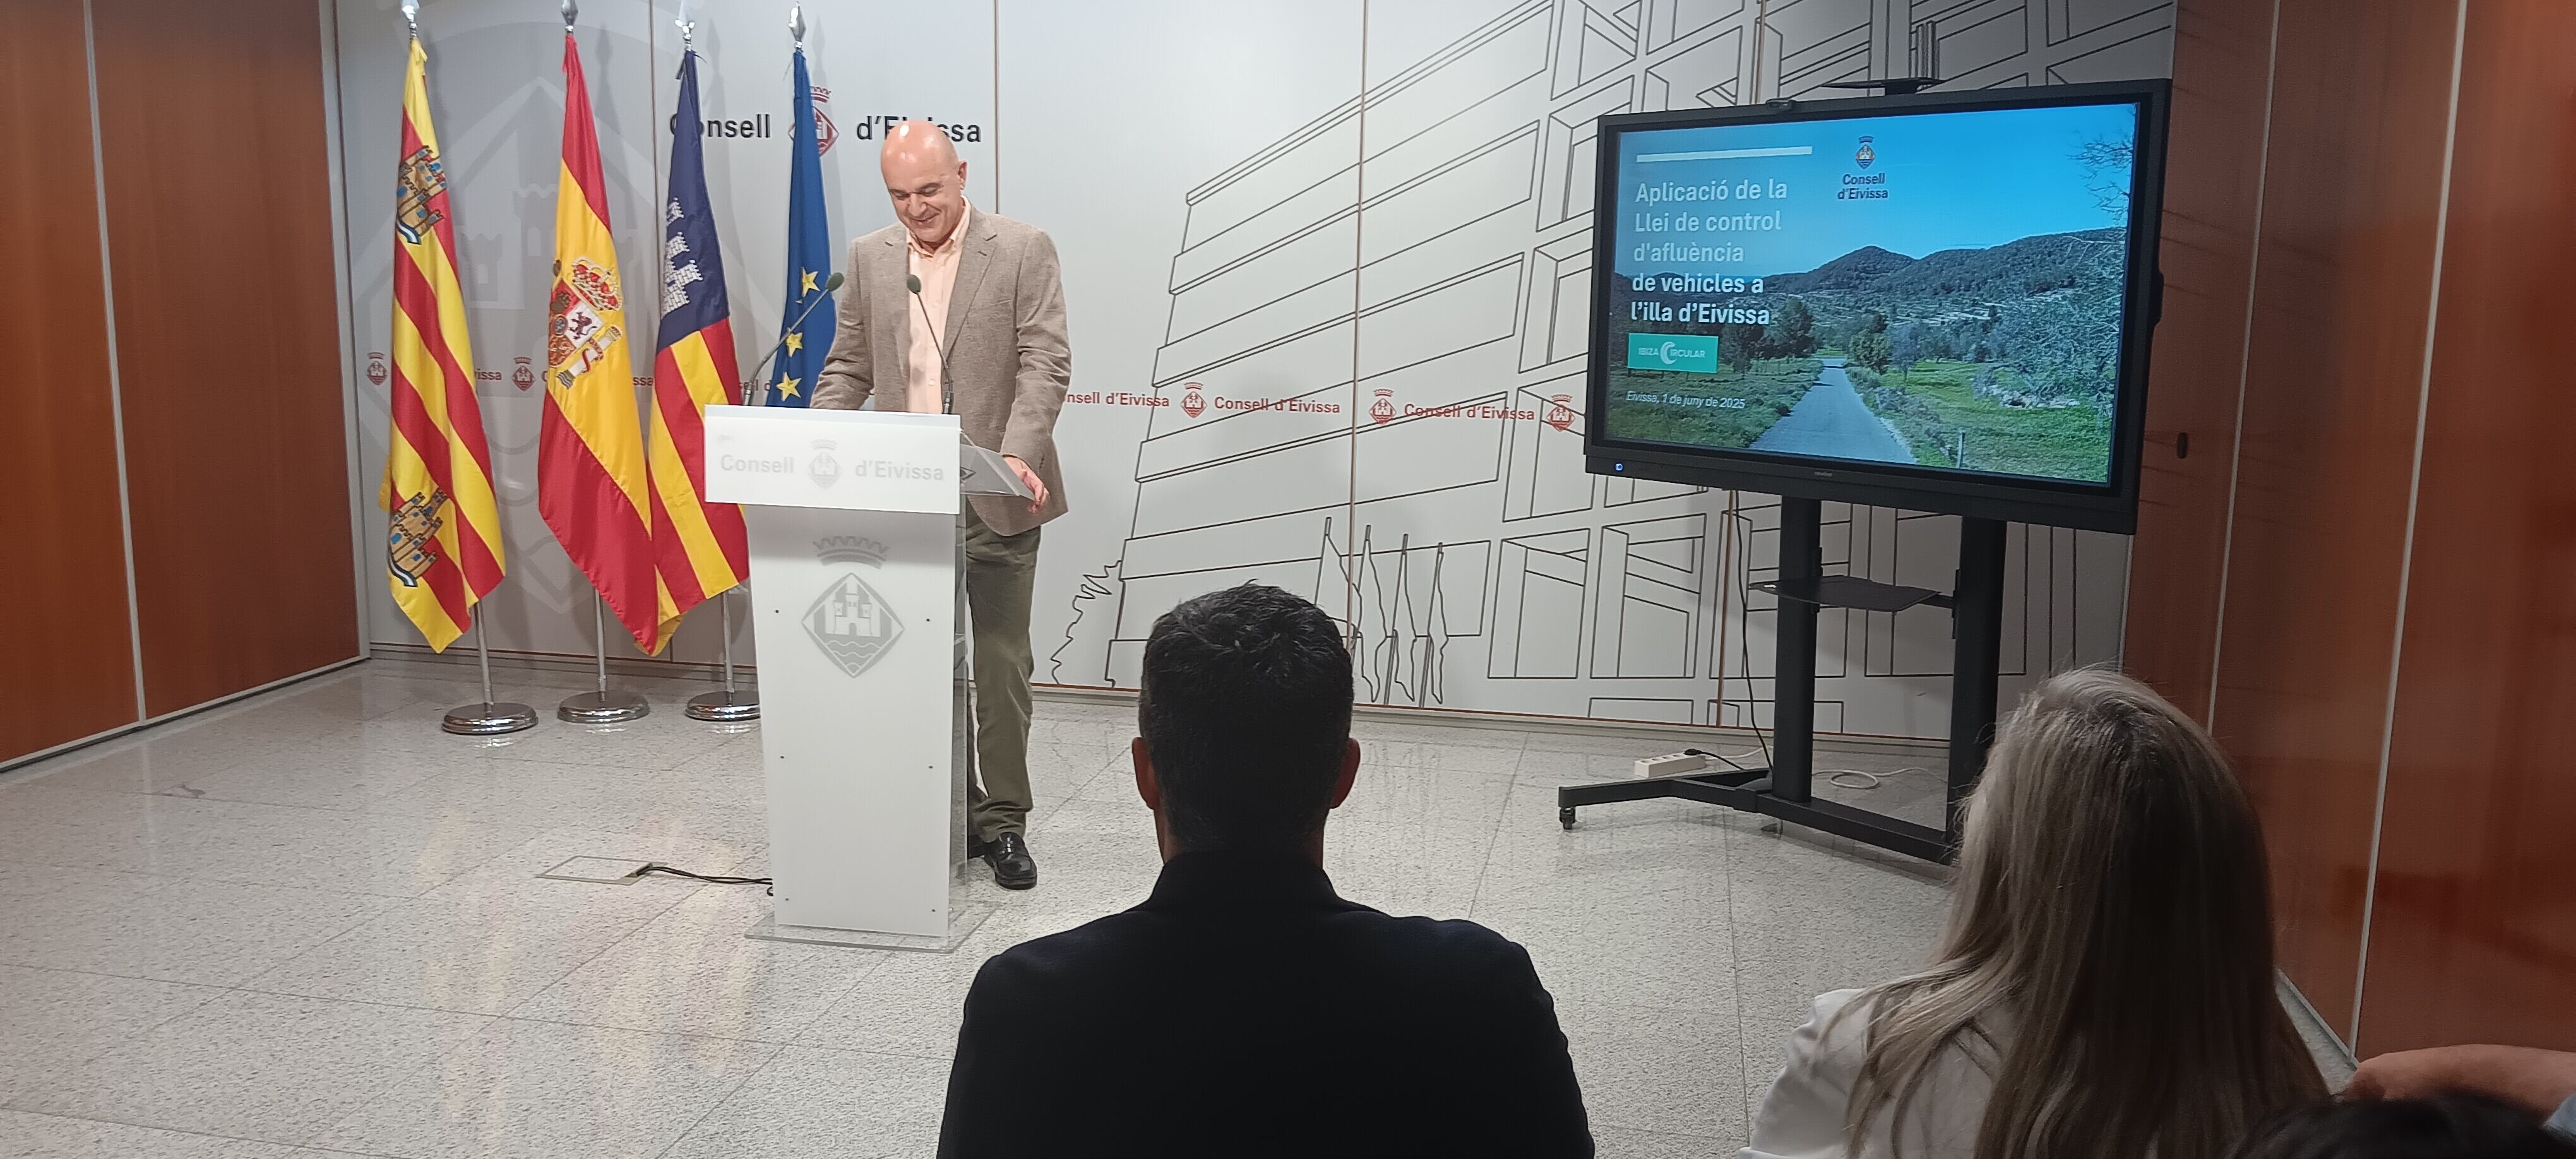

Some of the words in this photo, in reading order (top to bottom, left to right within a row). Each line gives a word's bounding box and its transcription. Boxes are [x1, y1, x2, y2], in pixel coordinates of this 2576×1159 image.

[669, 114, 770, 138] nsell
[1843, 172, 1885, 185] Consell
[1635, 179, 1729, 206] Aplicació
[1736, 179, 1762, 199] de
[1768, 178, 1787, 199] la
[1837, 187, 1888, 199] d'Eivissa
[1635, 212, 1669, 232] Llei
[1675, 211, 1700, 232] de
[1706, 210, 1782, 232] control
[1633, 241, 1744, 262] d'afluència
[1632, 272, 1656, 292] de
[1661, 272, 1745, 293] vehicles
[1751, 278, 1763, 294] a
[1631, 301, 1673, 322] l'illa
[1679, 302, 1770, 324] d'Eivissa
[1638, 347, 1659, 356] IBIZA
[1065, 392, 1100, 405] nsell
[1106, 393, 1169, 407] d'Eivissa
[1215, 396, 1268, 411] Consell
[1275, 398, 1340, 413] d'Eivissa
[1626, 391, 1661, 405] Eivissa,
[1662, 393, 1667, 403] 1
[1669, 394, 1682, 405] de
[1682, 395, 1704, 408] juny
[1705, 396, 1718, 407] de
[1719, 398, 1746, 409] 2025
[1404, 403, 1461, 418] Consell
[1467, 405, 1535, 420] d'Eivissa
[720, 454, 794, 474] Consell
[855, 460, 945, 481] d'Eivissa
